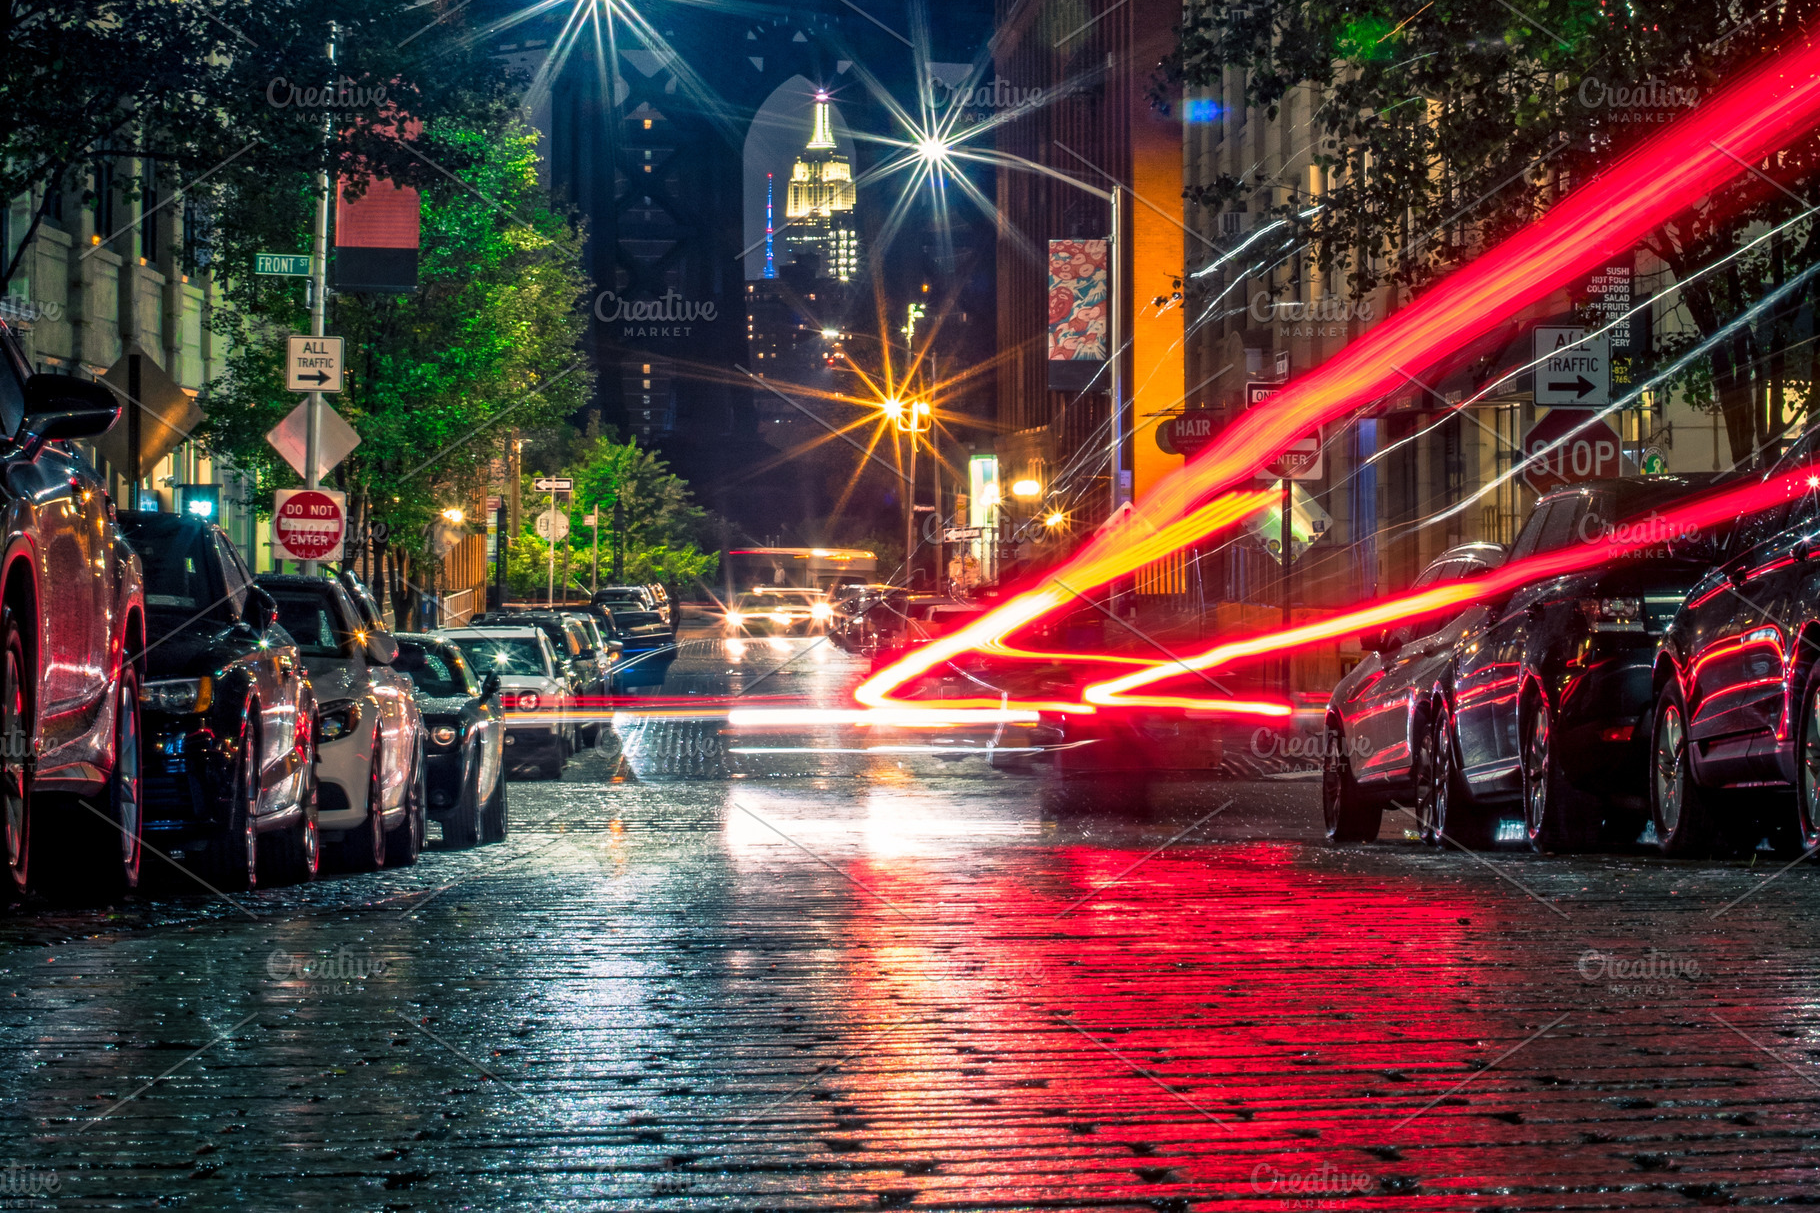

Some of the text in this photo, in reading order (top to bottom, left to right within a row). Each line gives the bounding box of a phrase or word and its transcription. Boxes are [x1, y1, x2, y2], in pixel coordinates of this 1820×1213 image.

[258, 257, 309, 273] FRONT ST
[1606, 267, 1630, 275] SUSHI
[1592, 276, 1630, 284] HOT FOOD
[1587, 285, 1630, 293] COLD FOOD
[1604, 294, 1630, 302] SALAD
[1602, 303, 1630, 311] FRUITS
[303, 342, 328, 354] ALL
[1554, 332, 1590, 352] ALL
[297, 357, 334, 369] TRAFFIC
[1547, 357, 1598, 372] TRAFFIC
[1175, 419, 1211, 437] HAIR
[1531, 439, 1614, 476] STOP
[286, 504, 334, 516] DO NOT
[290, 534, 328, 546] ENTER
